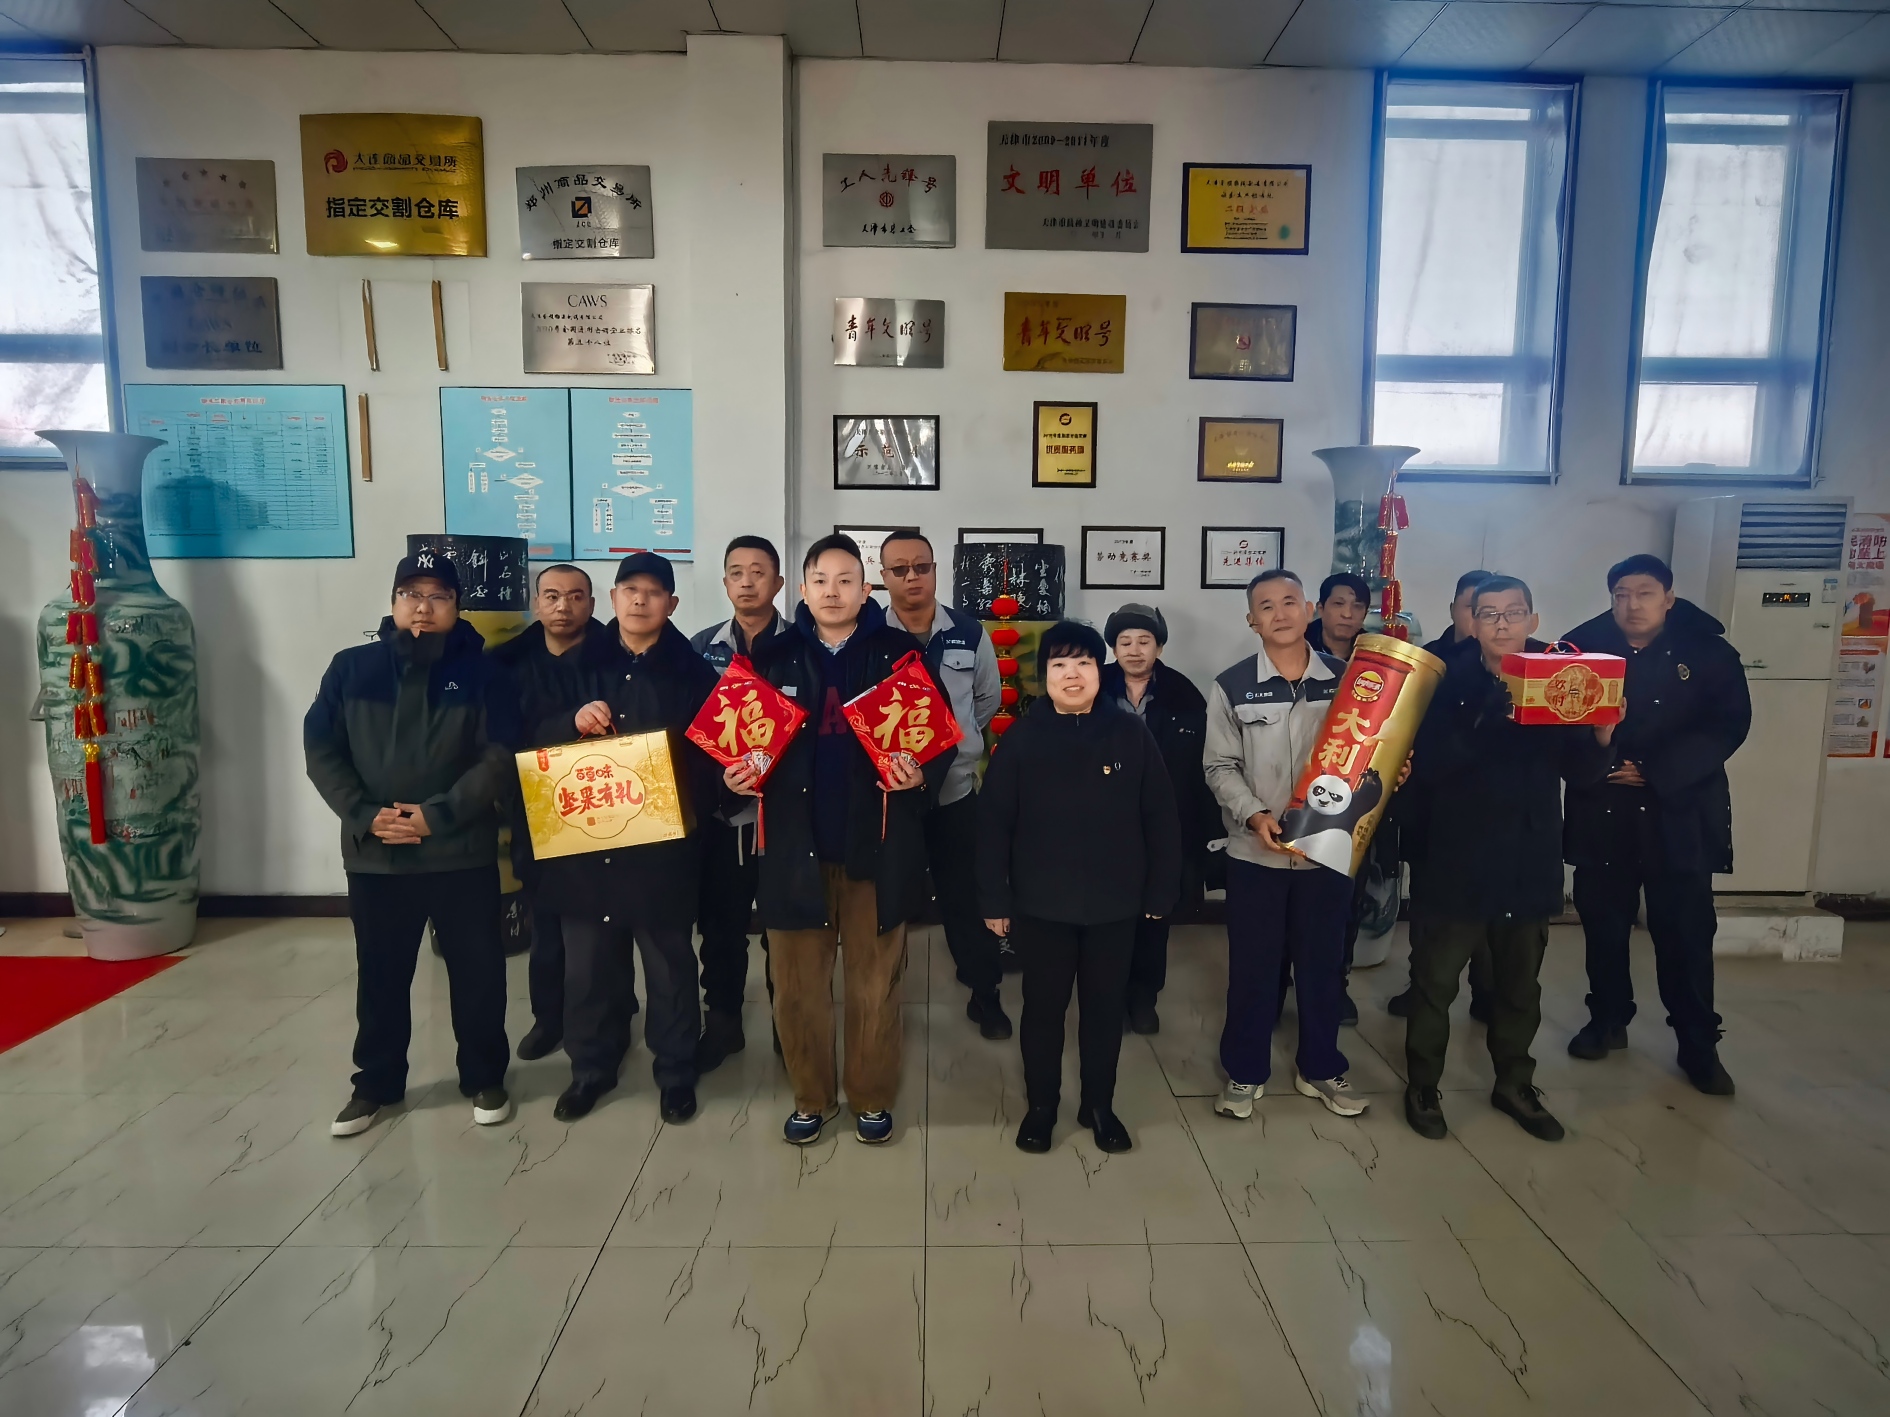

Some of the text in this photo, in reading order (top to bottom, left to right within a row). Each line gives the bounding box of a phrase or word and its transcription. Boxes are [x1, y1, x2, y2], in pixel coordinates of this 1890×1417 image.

[525, 173, 642, 211] 郑州商品交易所
[840, 163, 937, 194] 工人先锋号
[1001, 164, 1137, 200] 文明单位
[326, 196, 460, 219] 指定交割仓库
[552, 236, 620, 250] 指定交割仓库
[567, 294, 608, 308] CAWS
[845, 314, 932, 344] 青年文明号
[1017, 316, 1112, 347] 青年文明号
[417, 554, 435, 569] NY
[713, 689, 776, 757] 福
[873, 686, 935, 754] 福
[1318, 707, 1371, 775] 大利
[575, 763, 615, 783] 百草味
[558, 779, 644, 818] 坚果有礼
